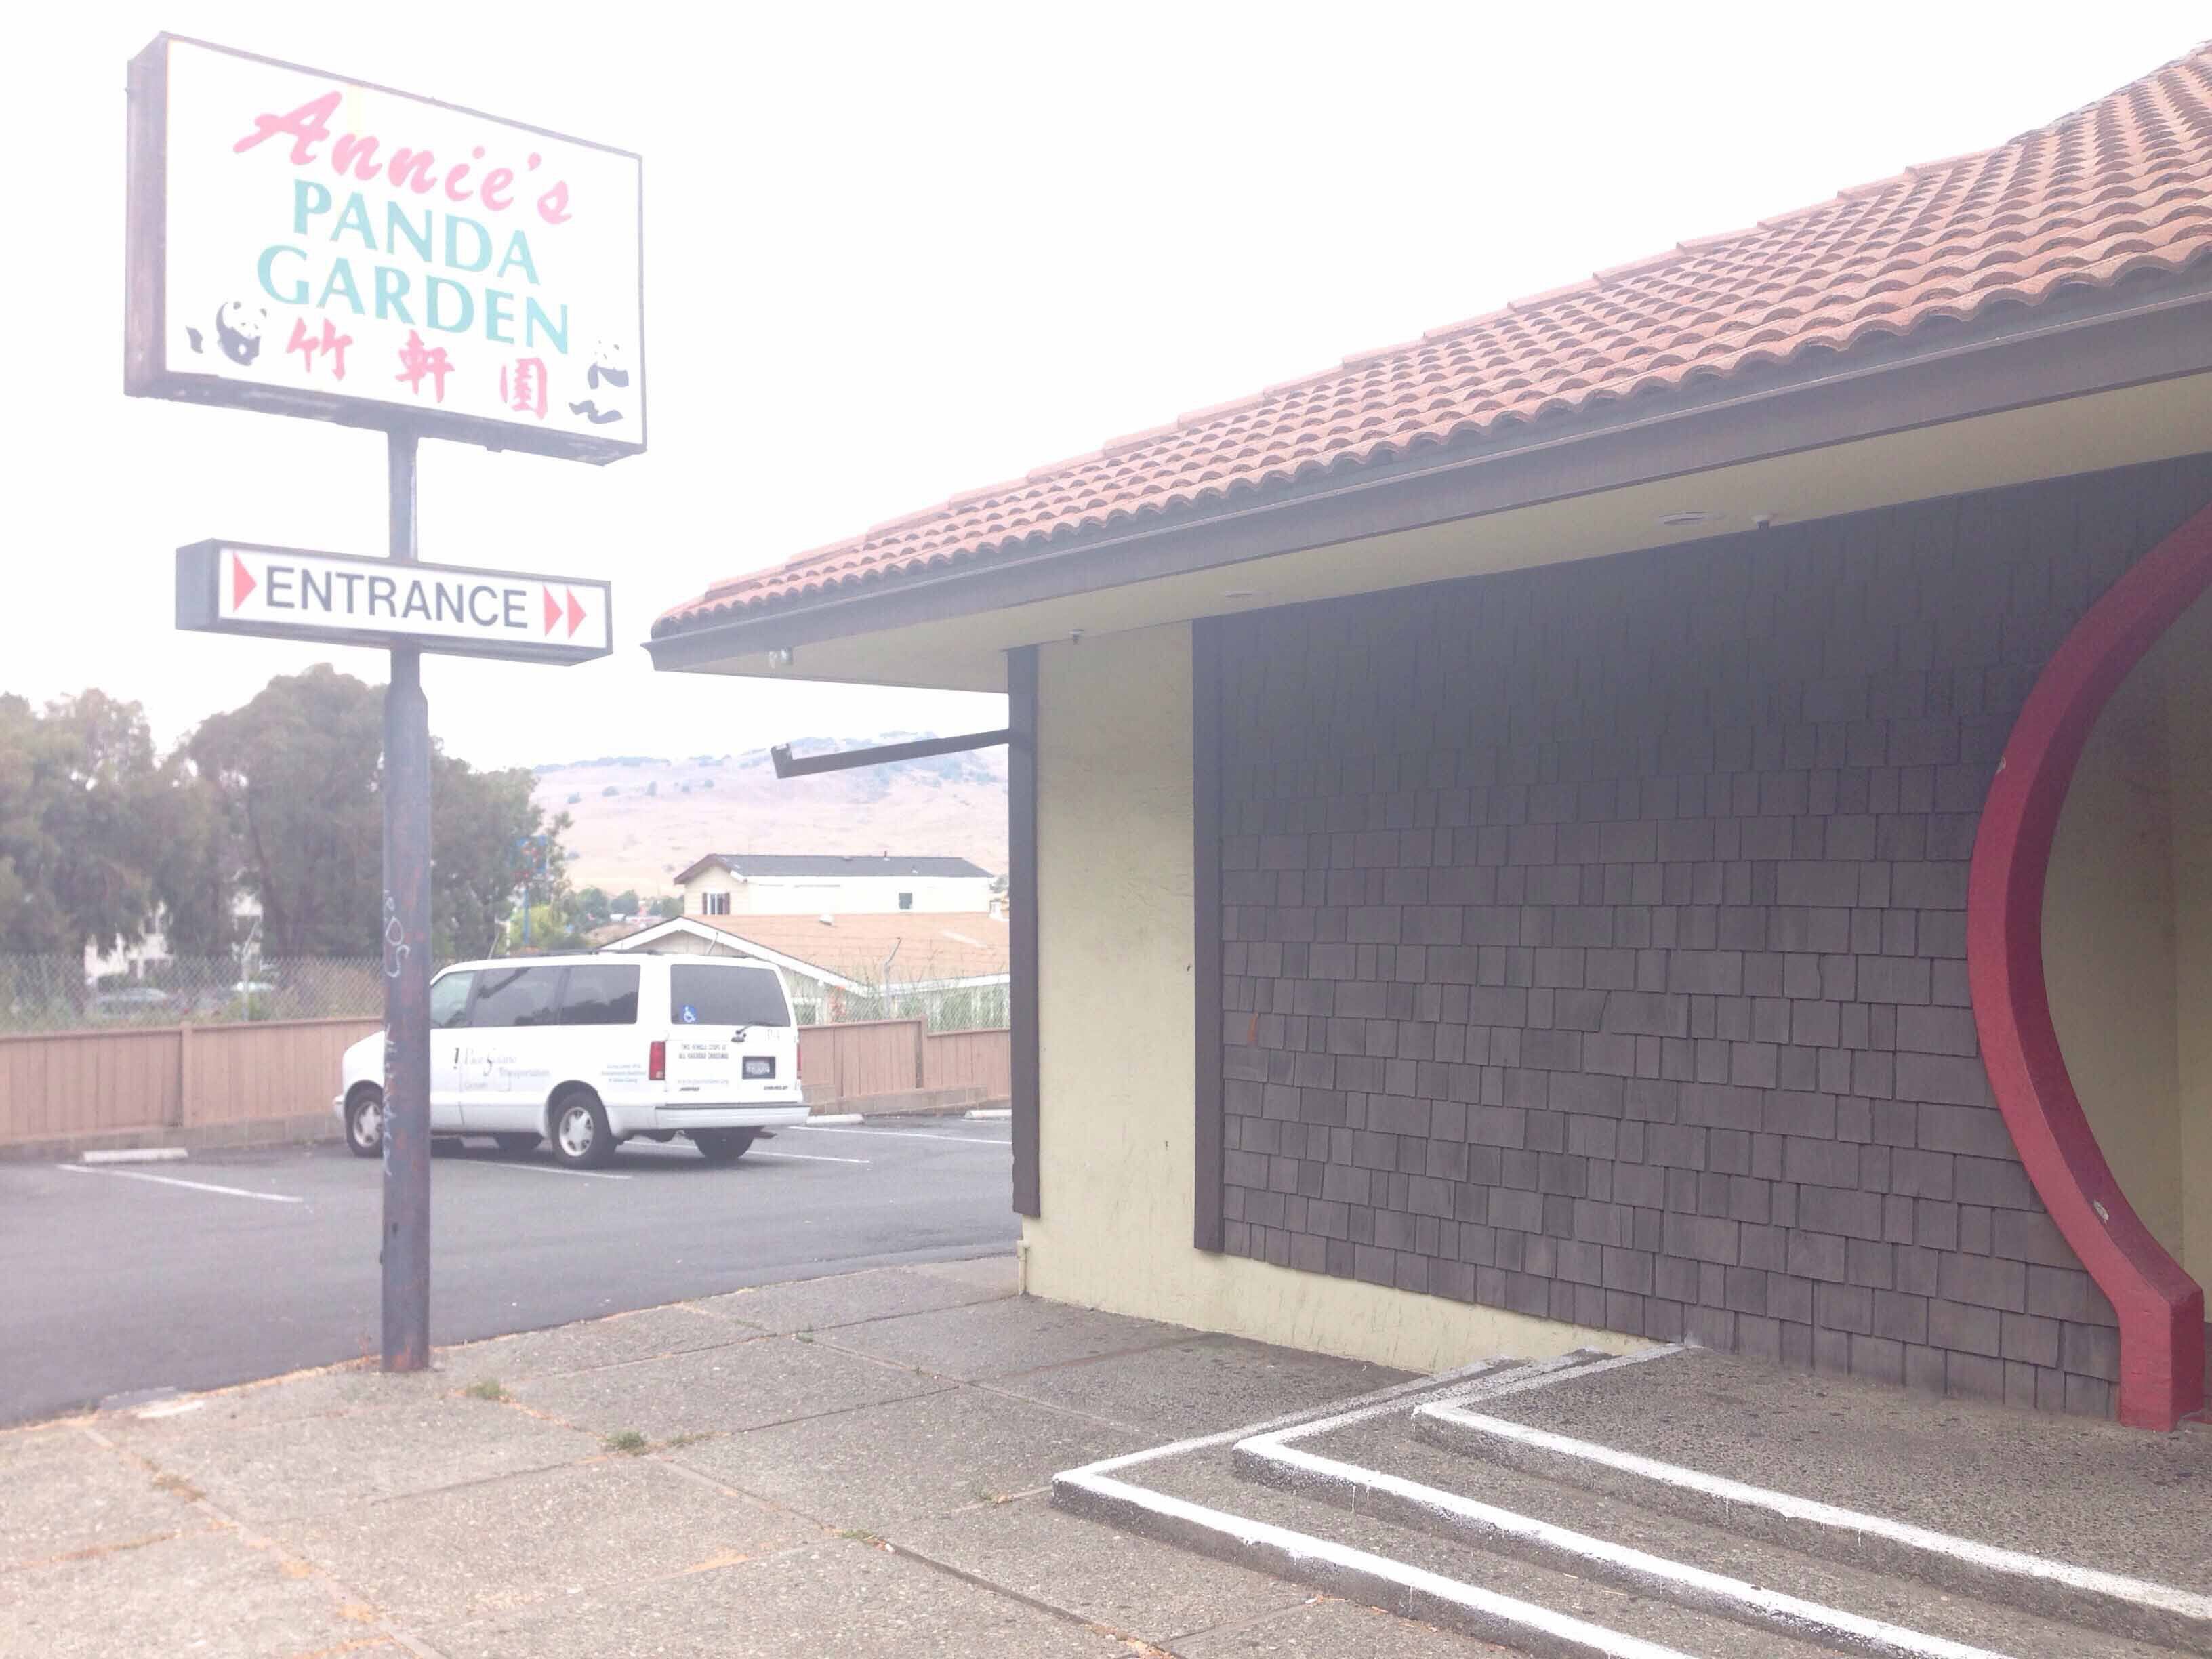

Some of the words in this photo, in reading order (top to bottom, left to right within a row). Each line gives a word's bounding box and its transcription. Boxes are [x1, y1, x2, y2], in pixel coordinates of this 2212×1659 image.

[233, 90, 572, 225] Annie's
[293, 178, 541, 286] PANDA
[257, 245, 569, 354] GARDEN
[266, 565, 529, 630] ENTRANCE
